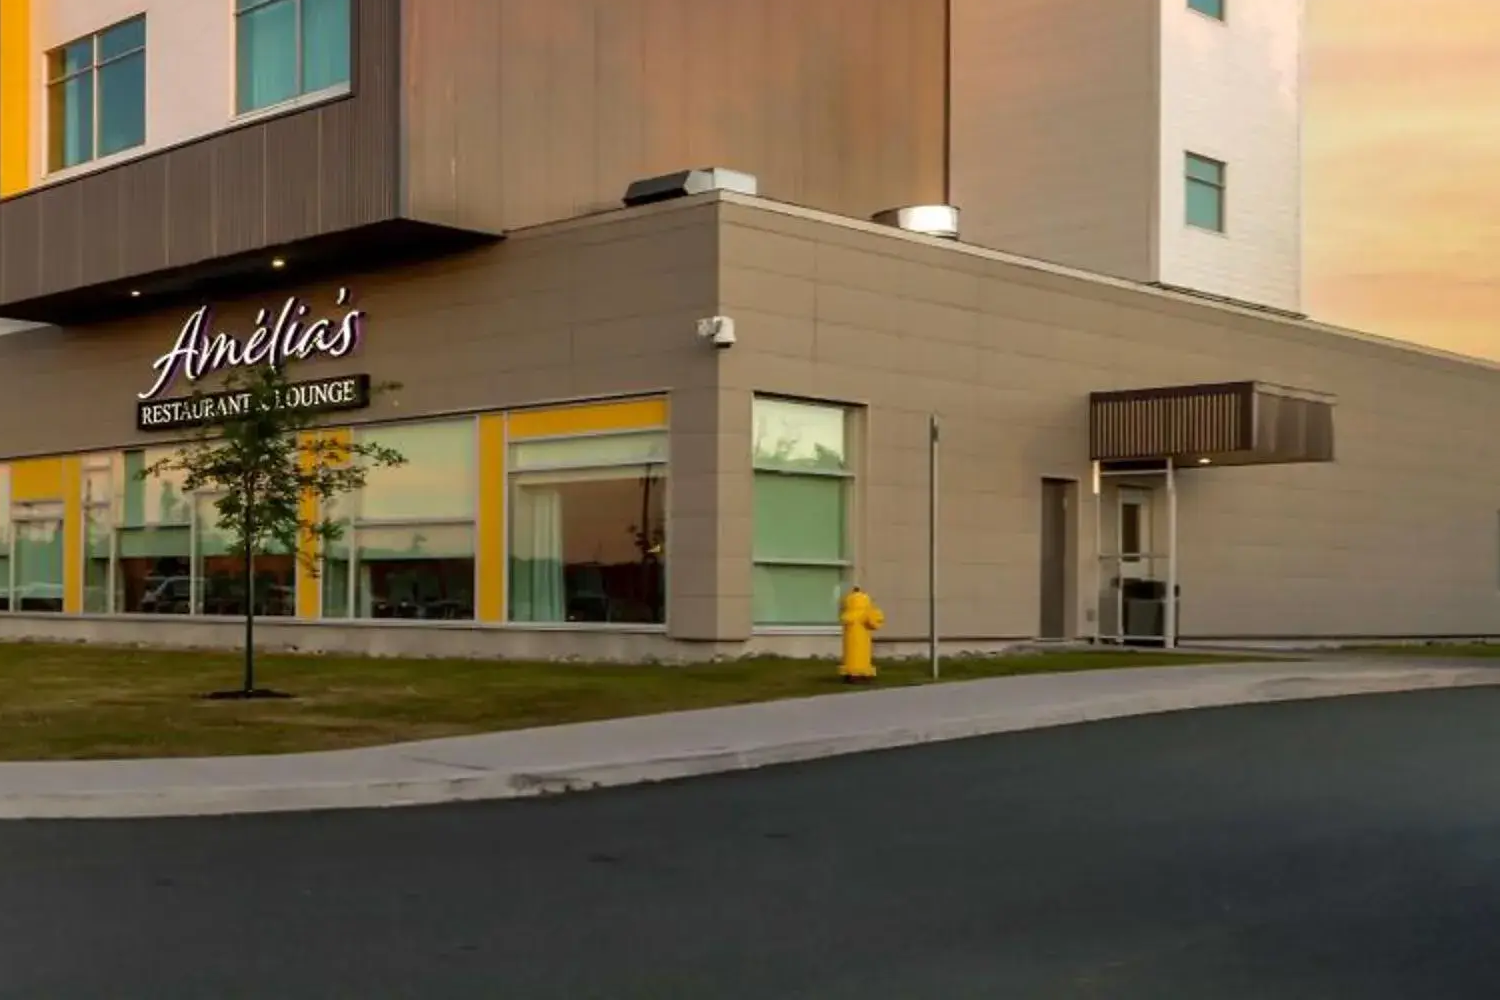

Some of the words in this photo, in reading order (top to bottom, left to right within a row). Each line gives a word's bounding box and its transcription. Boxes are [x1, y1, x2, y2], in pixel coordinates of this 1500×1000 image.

[137, 287, 360, 399] Amélia's
[141, 394, 252, 425] RESTAURANT
[274, 380, 356, 410] LOUNGE
